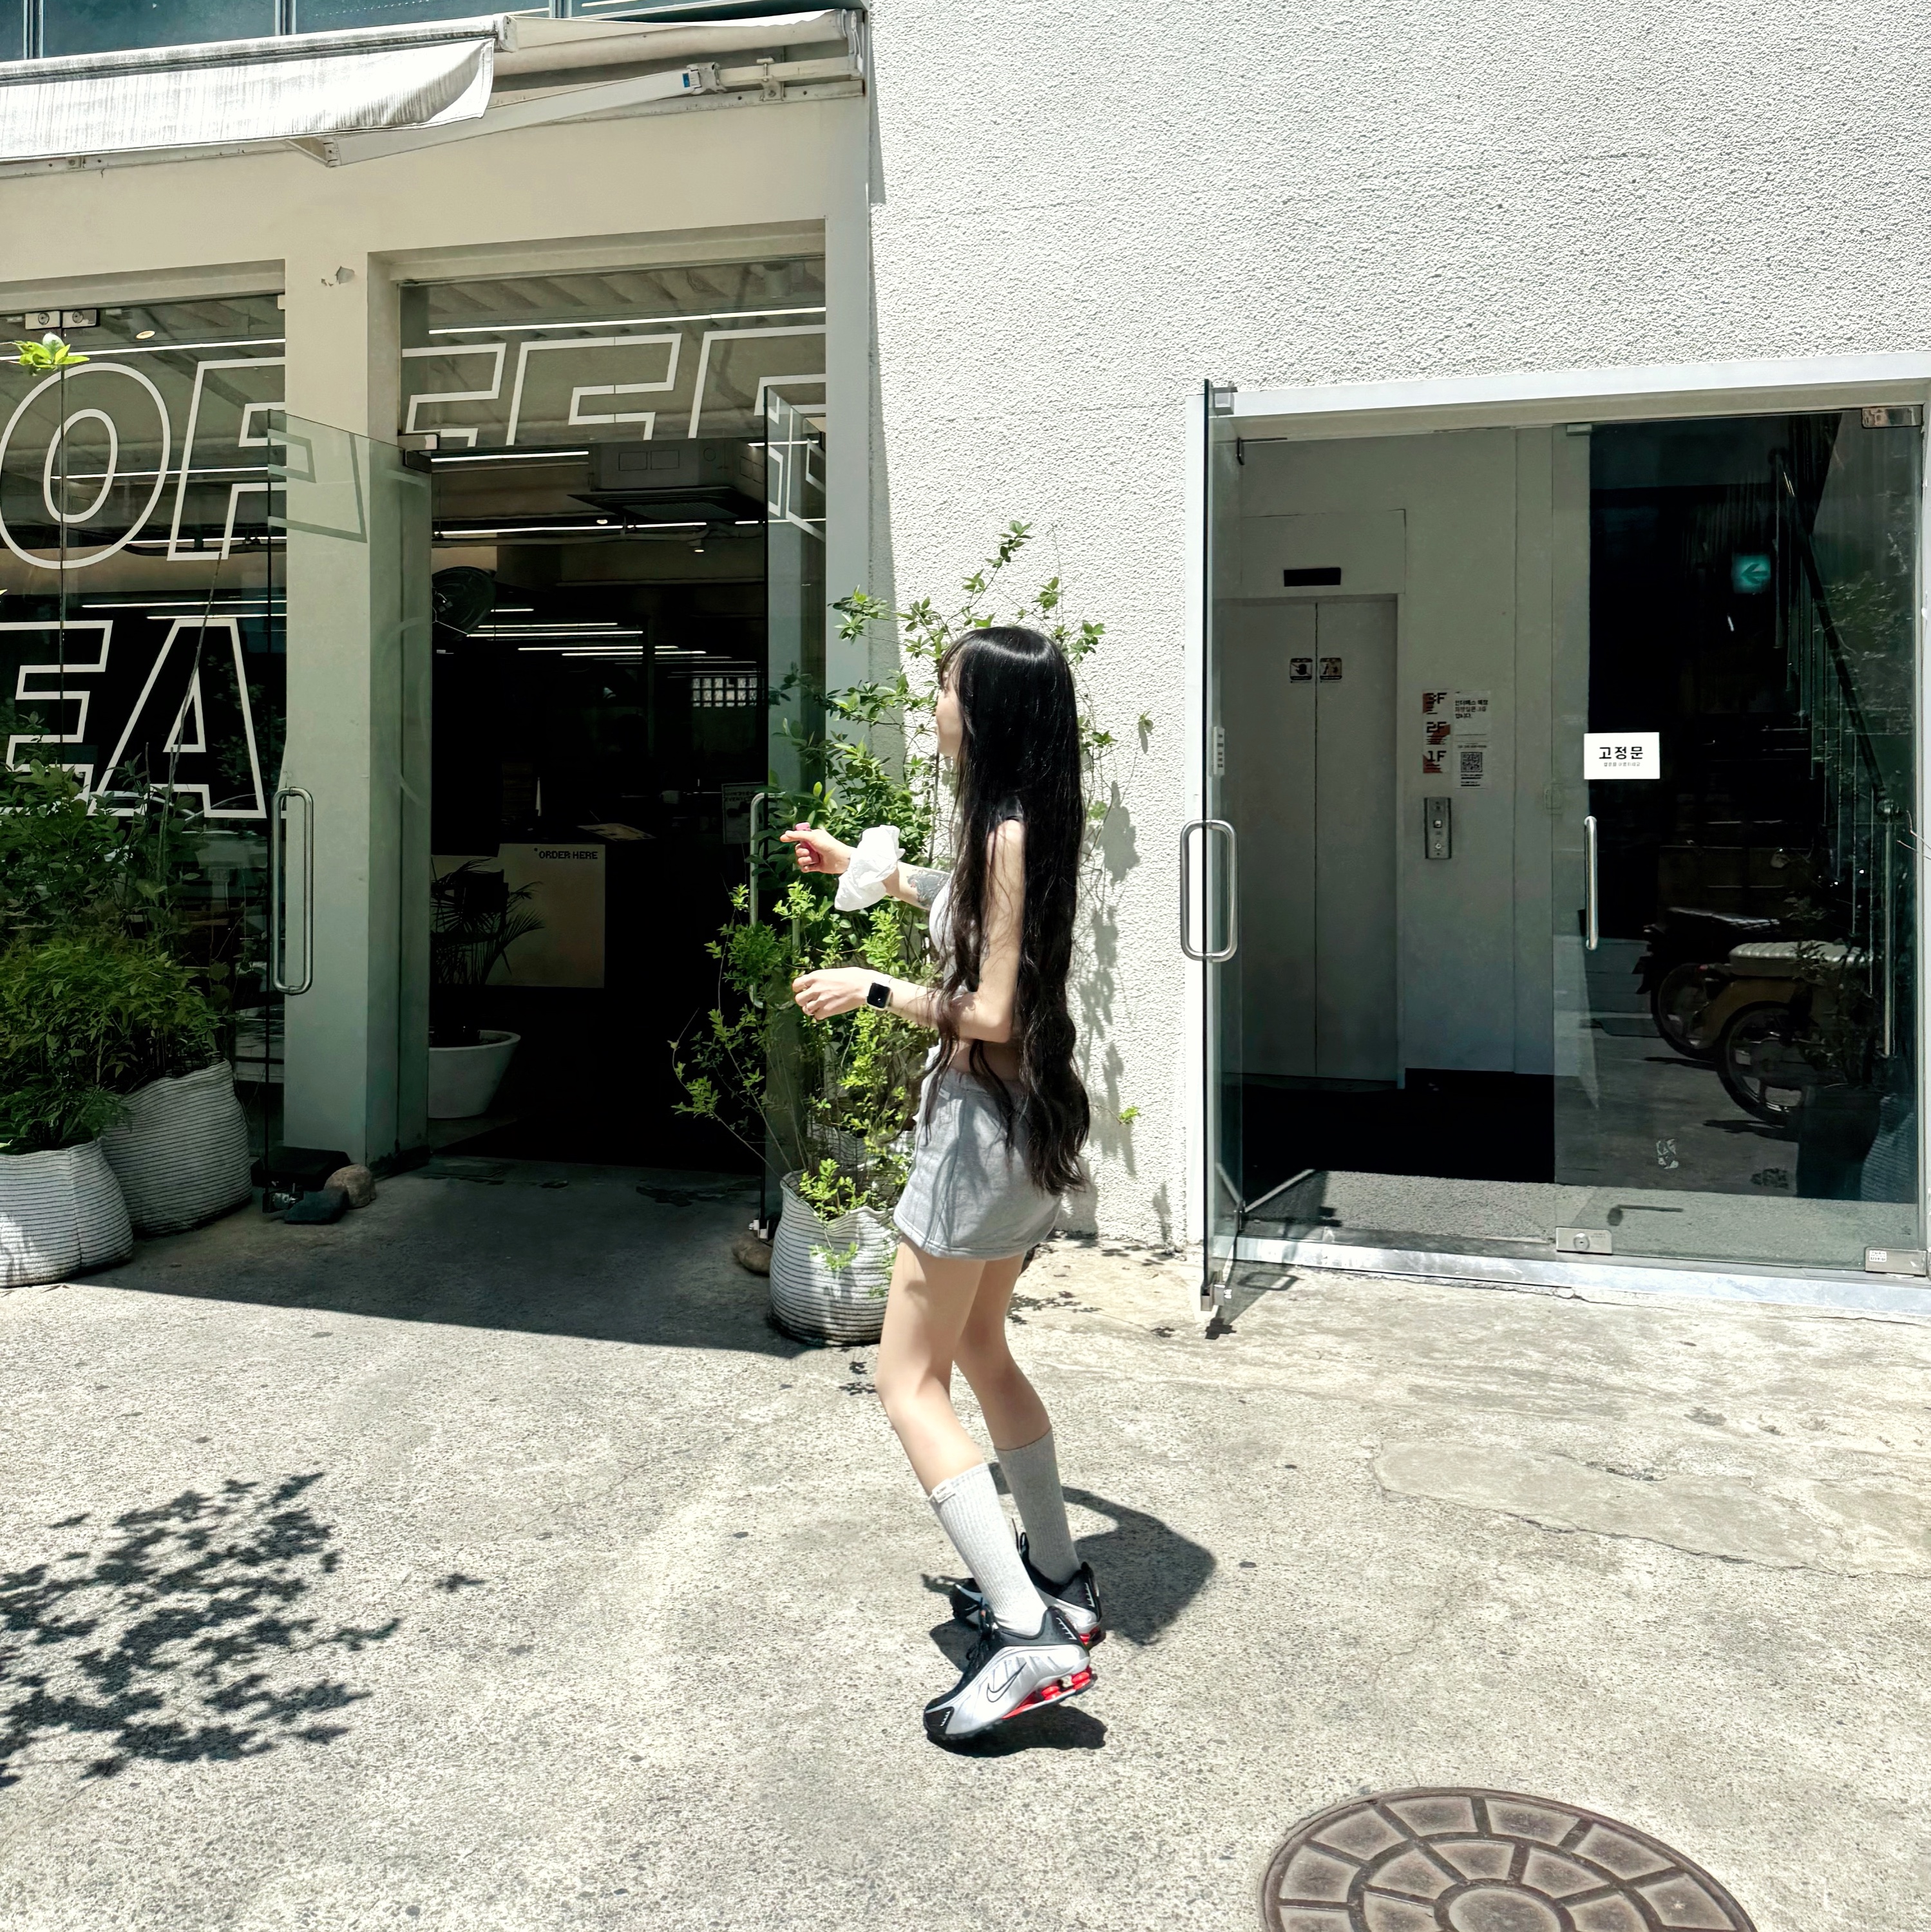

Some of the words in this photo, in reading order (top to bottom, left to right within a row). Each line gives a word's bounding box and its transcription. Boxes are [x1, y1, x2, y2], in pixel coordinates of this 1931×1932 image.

[1426, 721, 1447, 734] 2F
[1427, 750, 1447, 762] 1F
[1599, 746, 1644, 760] 고정문
[539, 851, 571, 859] ORDER
[573, 851, 598, 859] HERE
